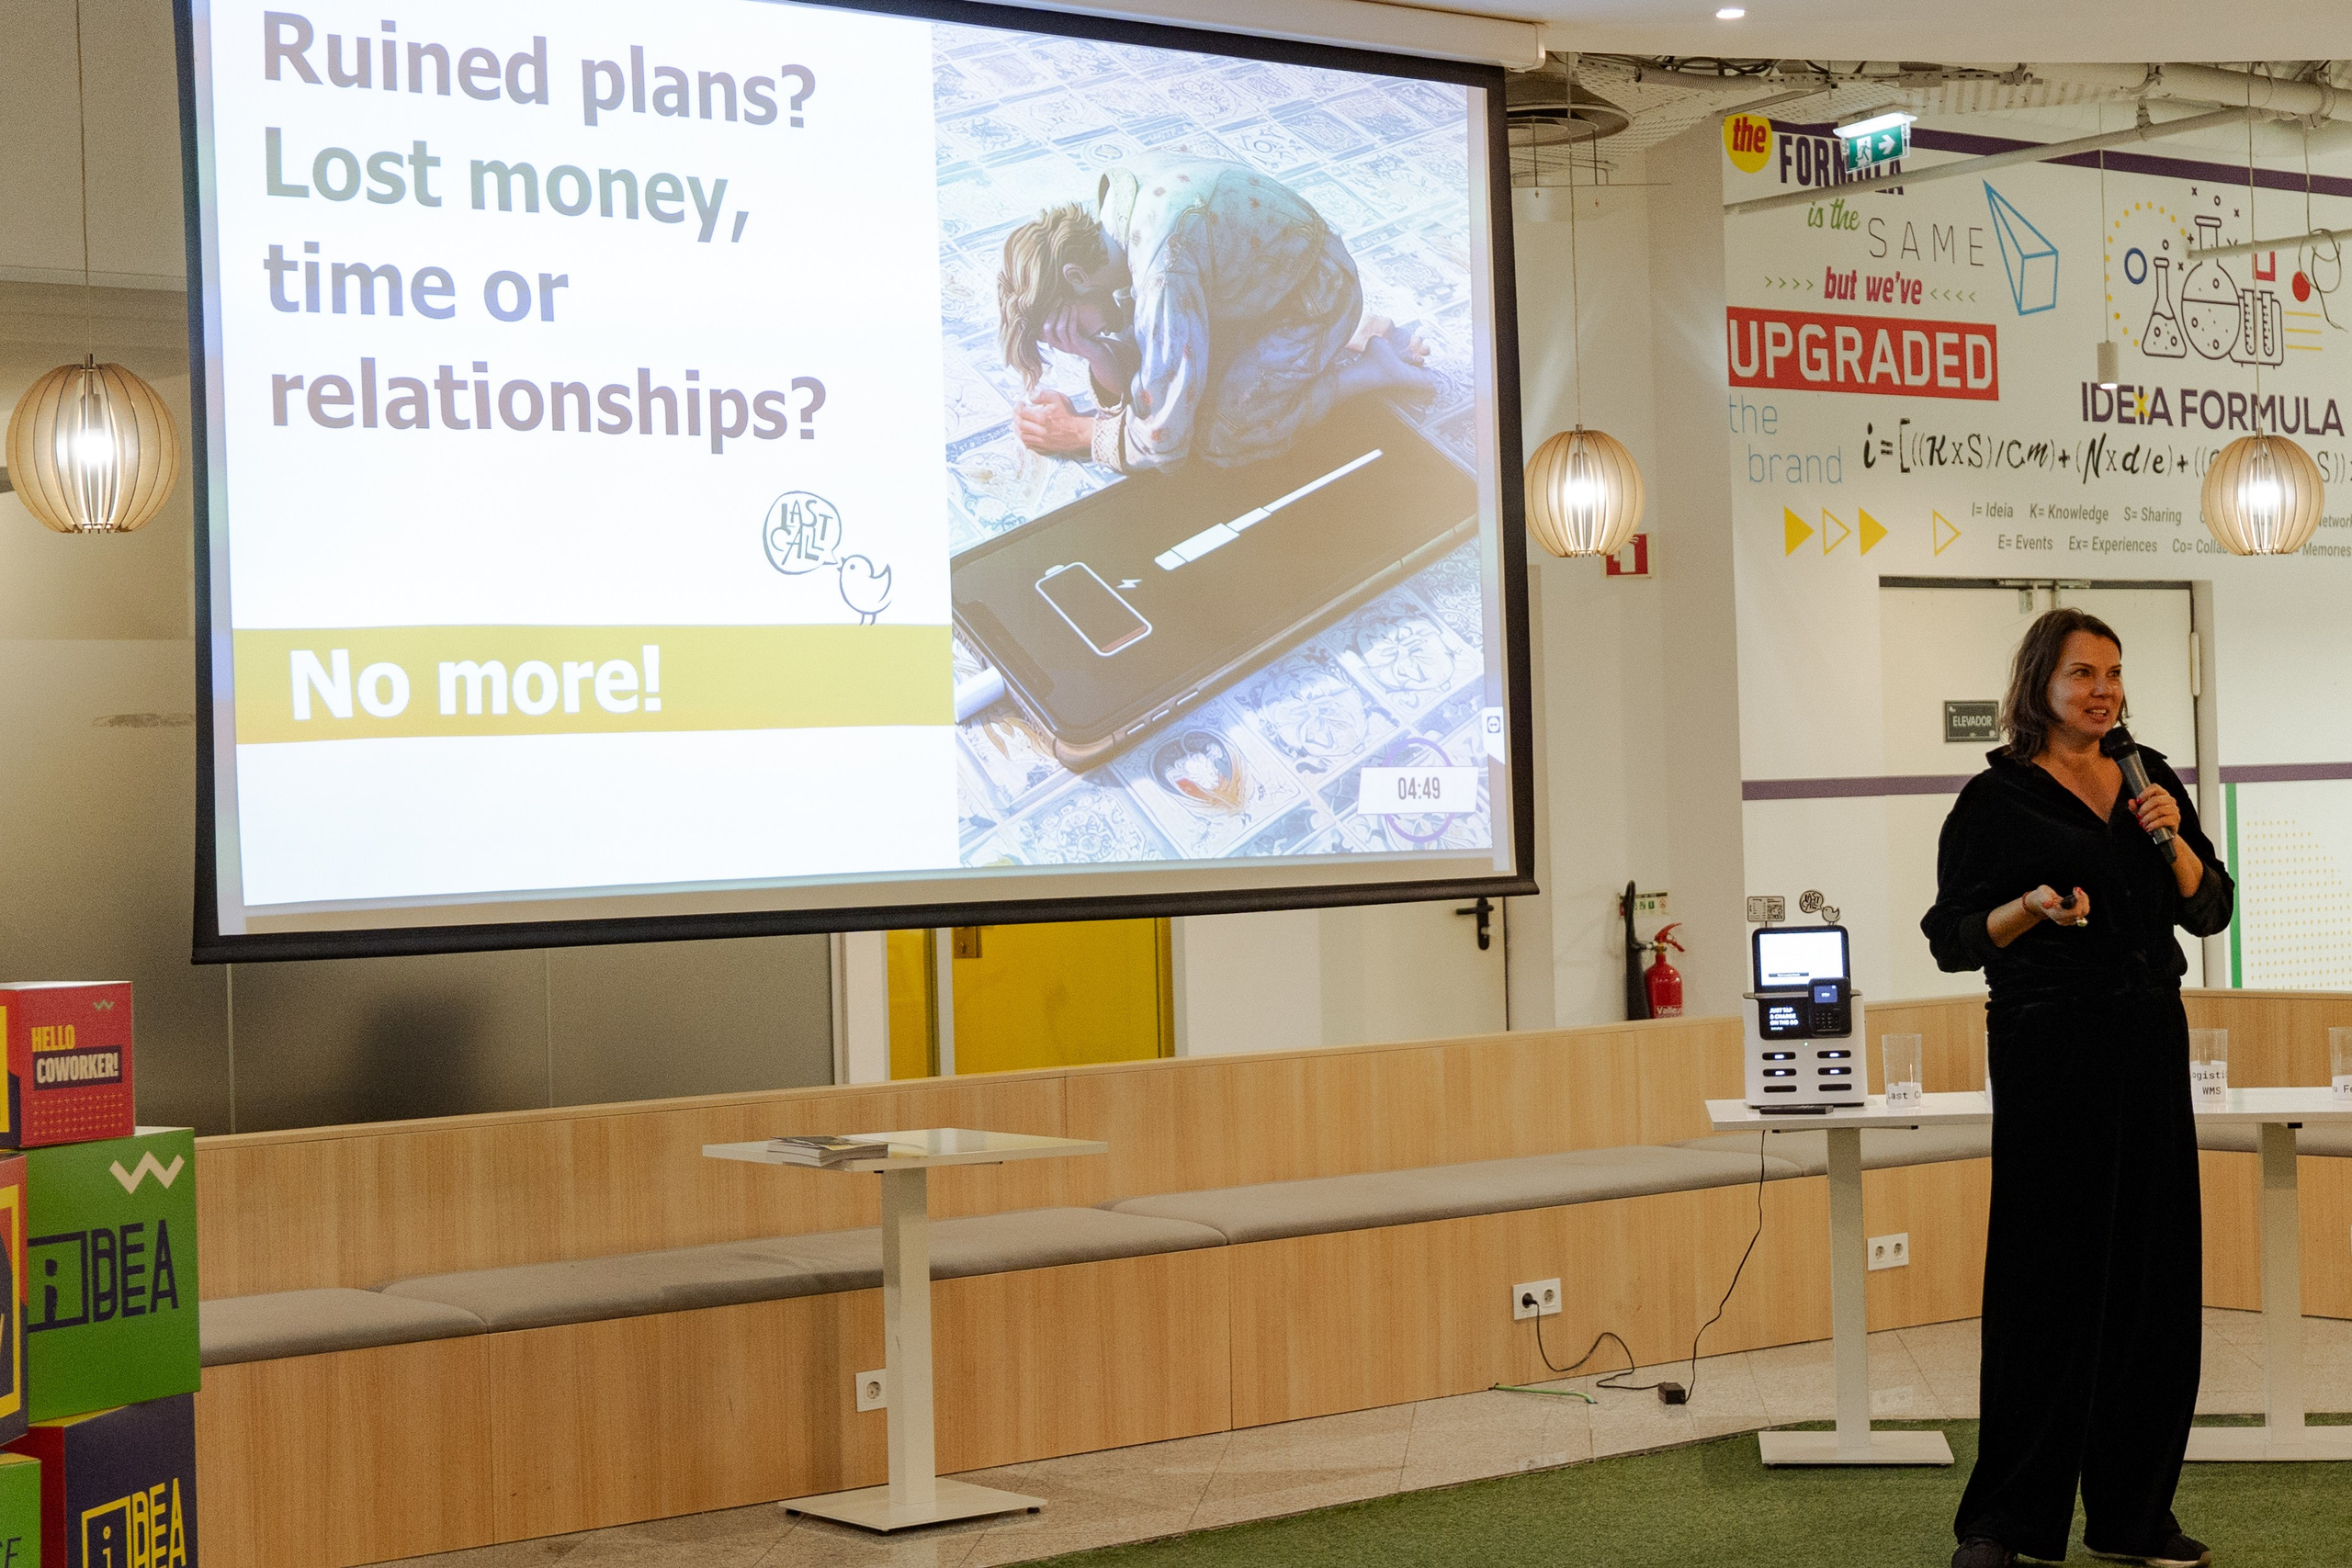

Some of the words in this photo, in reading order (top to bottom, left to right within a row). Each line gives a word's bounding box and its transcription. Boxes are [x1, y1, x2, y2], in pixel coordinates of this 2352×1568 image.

[264, 10, 548, 106] Ruined
[582, 45, 816, 128] plans?
[1733, 116, 1766, 153] the
[265, 126, 443, 208] Lost
[470, 159, 749, 243] money,
[1807, 201, 1824, 230] is
[1830, 198, 1860, 231] the
[1868, 217, 1984, 266] SAME
[264, 242, 456, 319] time
[483, 270, 568, 321] or
[1824, 265, 1857, 301] but
[1866, 271, 1922, 304] we've
[1728, 319, 1993, 389] UPGRADED
[271, 357, 827, 454] relationships?
[1728, 394, 1778, 434] the
[2180, 389, 2345, 437] FORMULA
[1748, 444, 1842, 484] brand
[781, 499, 833, 541] LAST
[1985, 502, 2014, 518] Ideia
[2048, 504, 2109, 525] Knowledge
[2141, 506, 2182, 526] Sharing
[770, 525, 825, 566] CALL
[2016, 535, 2053, 550] Events
[2092, 536, 2157, 555] Experiences
[2302, 543, 2351, 557] Memories
[290, 648, 410, 720] No
[438, 645, 662, 716] more!
[1952, 715, 1992, 727] ELEVADOR
[1397, 776, 1441, 800] 04:49
[31, 1024, 75, 1053] HELLO
[36, 1052, 119, 1083] COWORKER!
[2202, 1087, 2222, 1096] WMS
